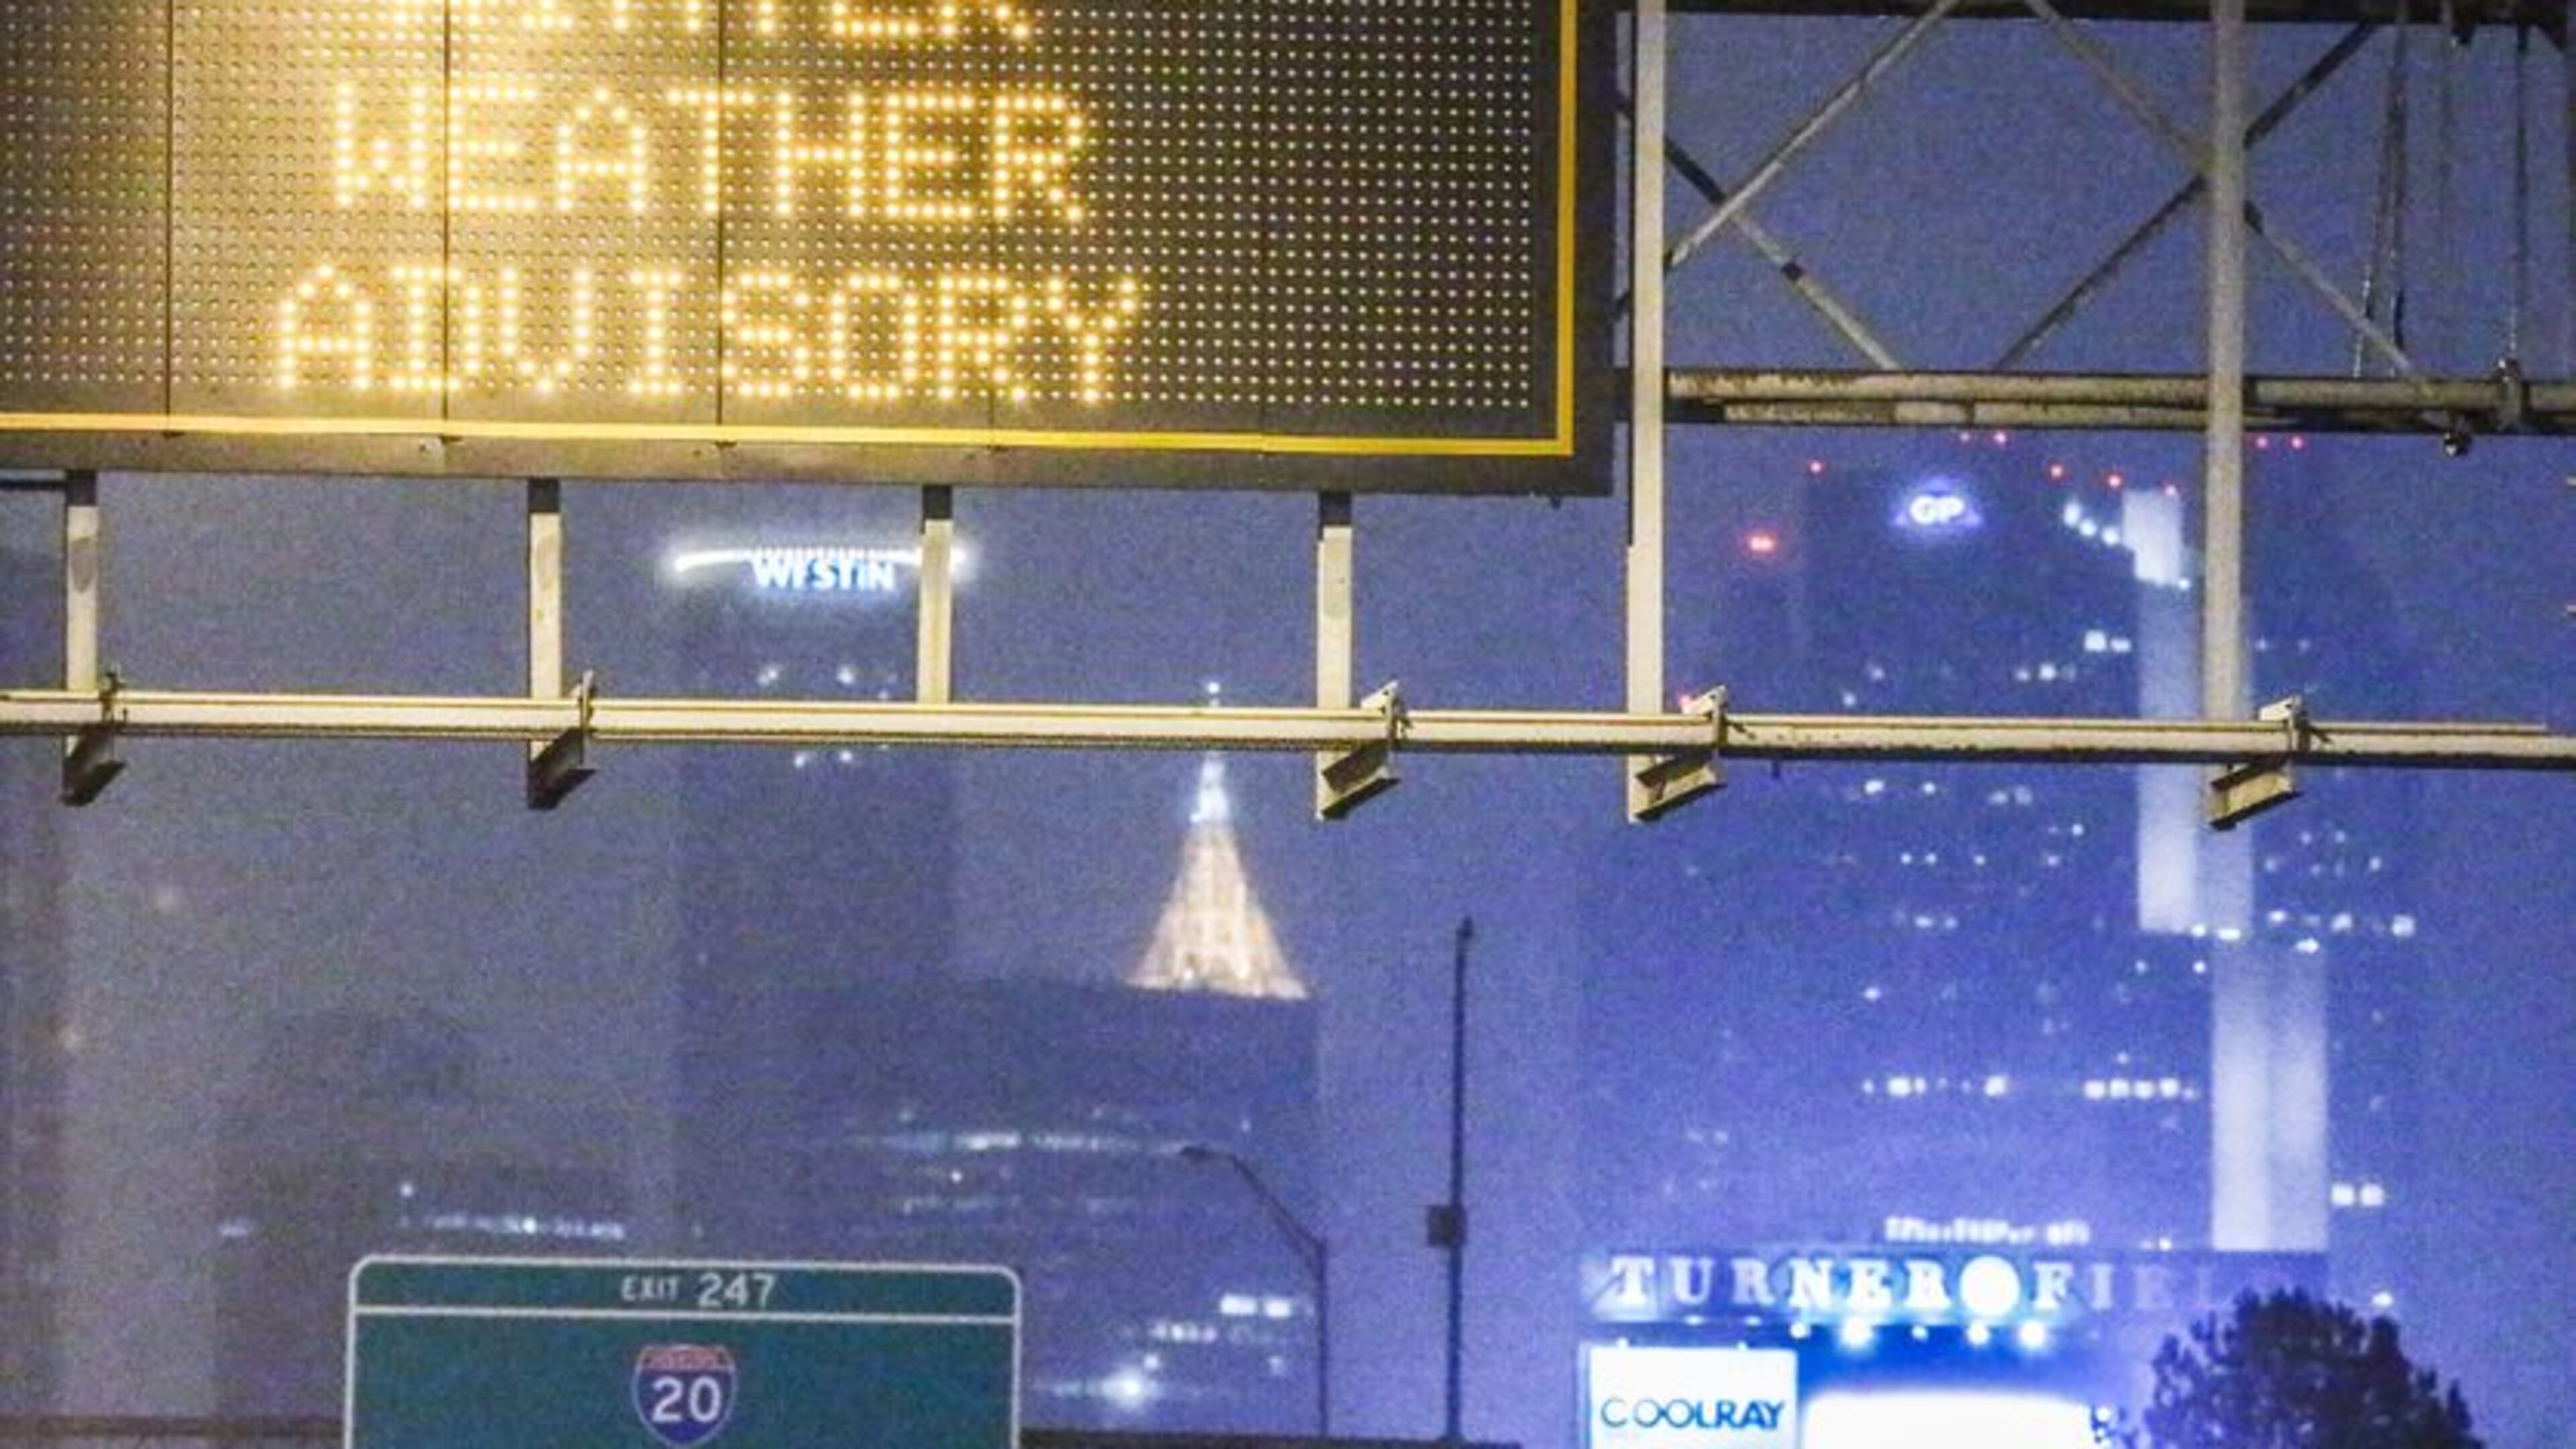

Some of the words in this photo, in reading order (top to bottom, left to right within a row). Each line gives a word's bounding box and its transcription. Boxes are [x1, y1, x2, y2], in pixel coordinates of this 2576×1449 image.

[335, 80, 1084, 225] WEATHER
[274, 262, 1140, 404] ADVISORY
[1910, 494, 1965, 525] GP
[621, 1275, 680, 1301] EXIT
[697, 1271, 777, 1309] 247
[1611, 1254, 1951, 1309] TURNER
[651, 1375, 722, 1424] 20
[1600, 1397, 1785, 1430] COOLRAY
